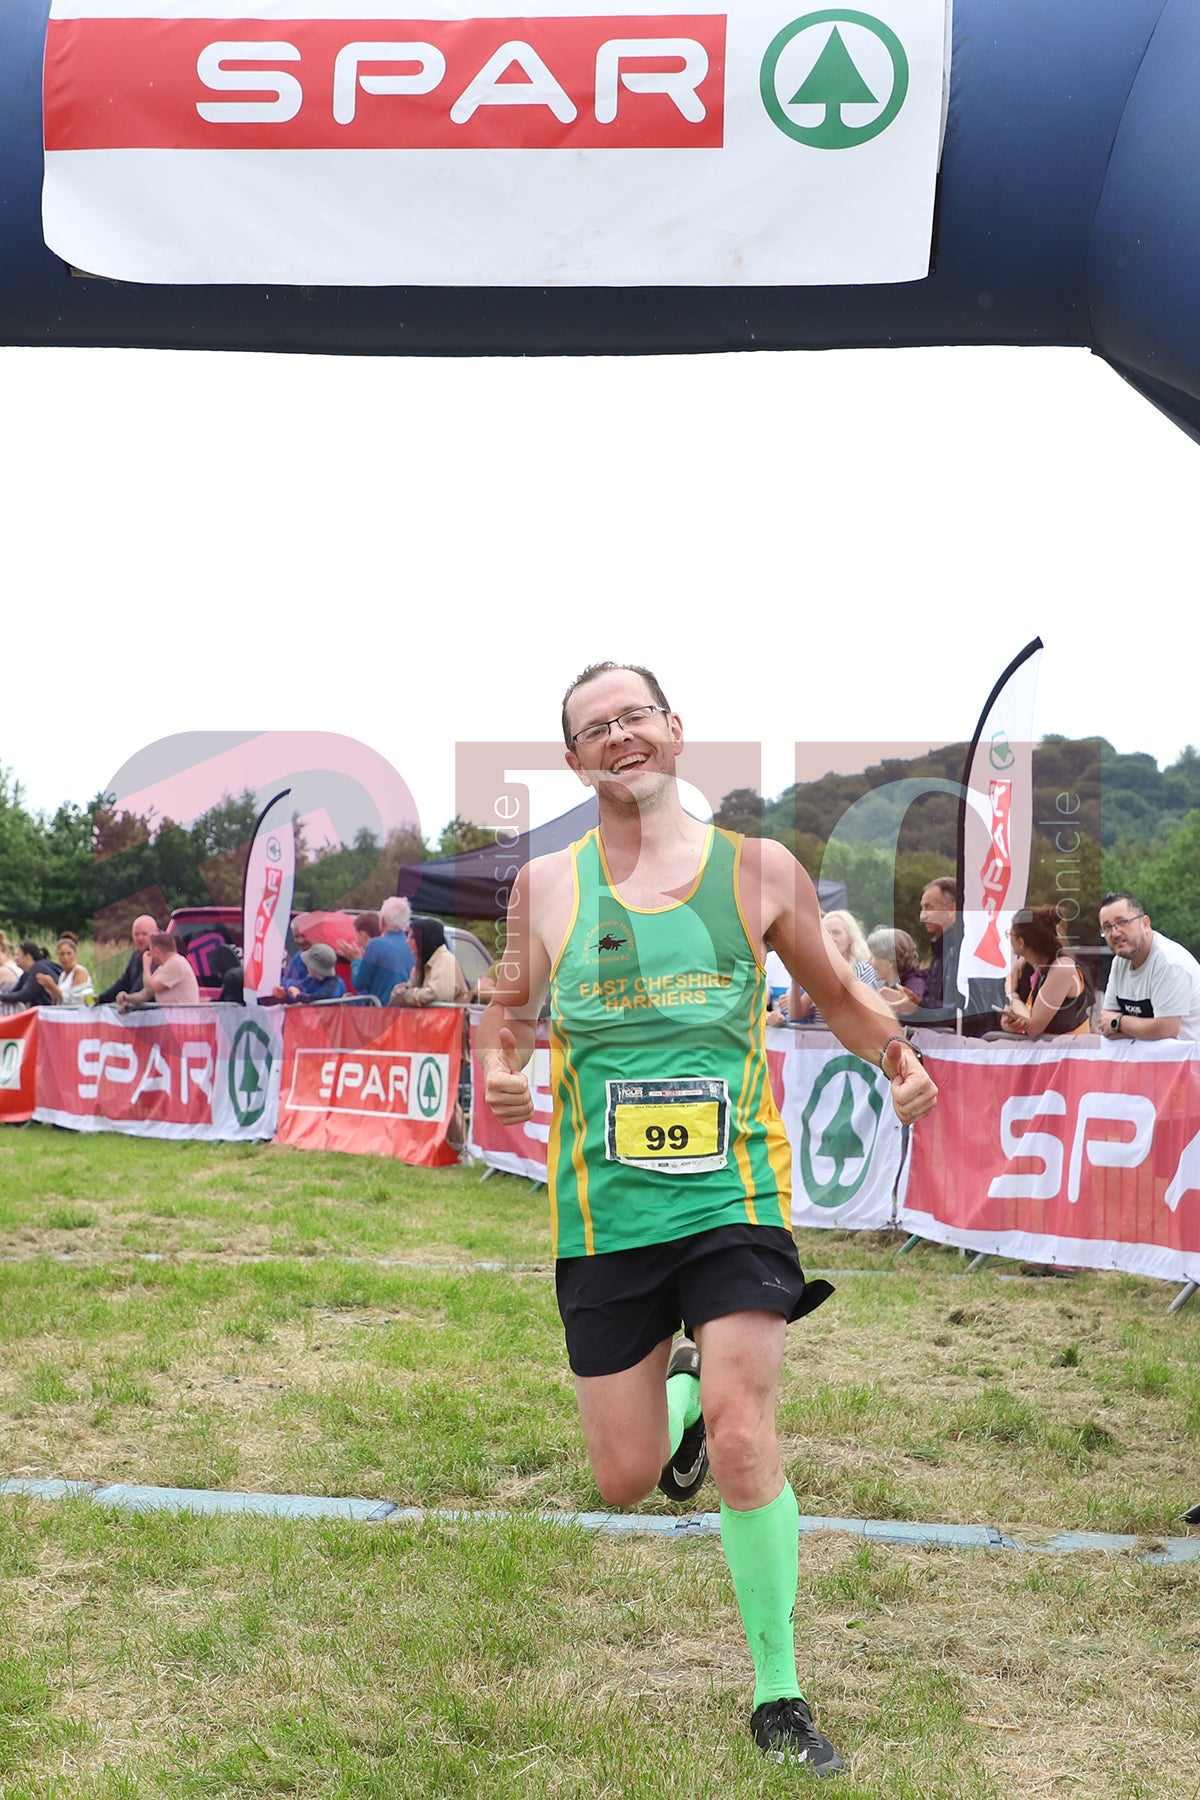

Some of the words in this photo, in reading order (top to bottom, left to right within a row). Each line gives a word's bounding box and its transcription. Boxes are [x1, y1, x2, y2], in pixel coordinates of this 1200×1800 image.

[196, 39, 708, 125] SPAR
[983, 783, 1008, 923] SPAR
[253, 868, 280, 963] SPAR
[579, 978, 629, 998] EAST
[633, 972, 733, 993] CHESHIRE
[604, 989, 708, 1012] HARRIERS
[78, 1038, 214, 1104] SPAR
[319, 1061, 408, 1103] SPAR
[645, 1125, 689, 1151] 99
